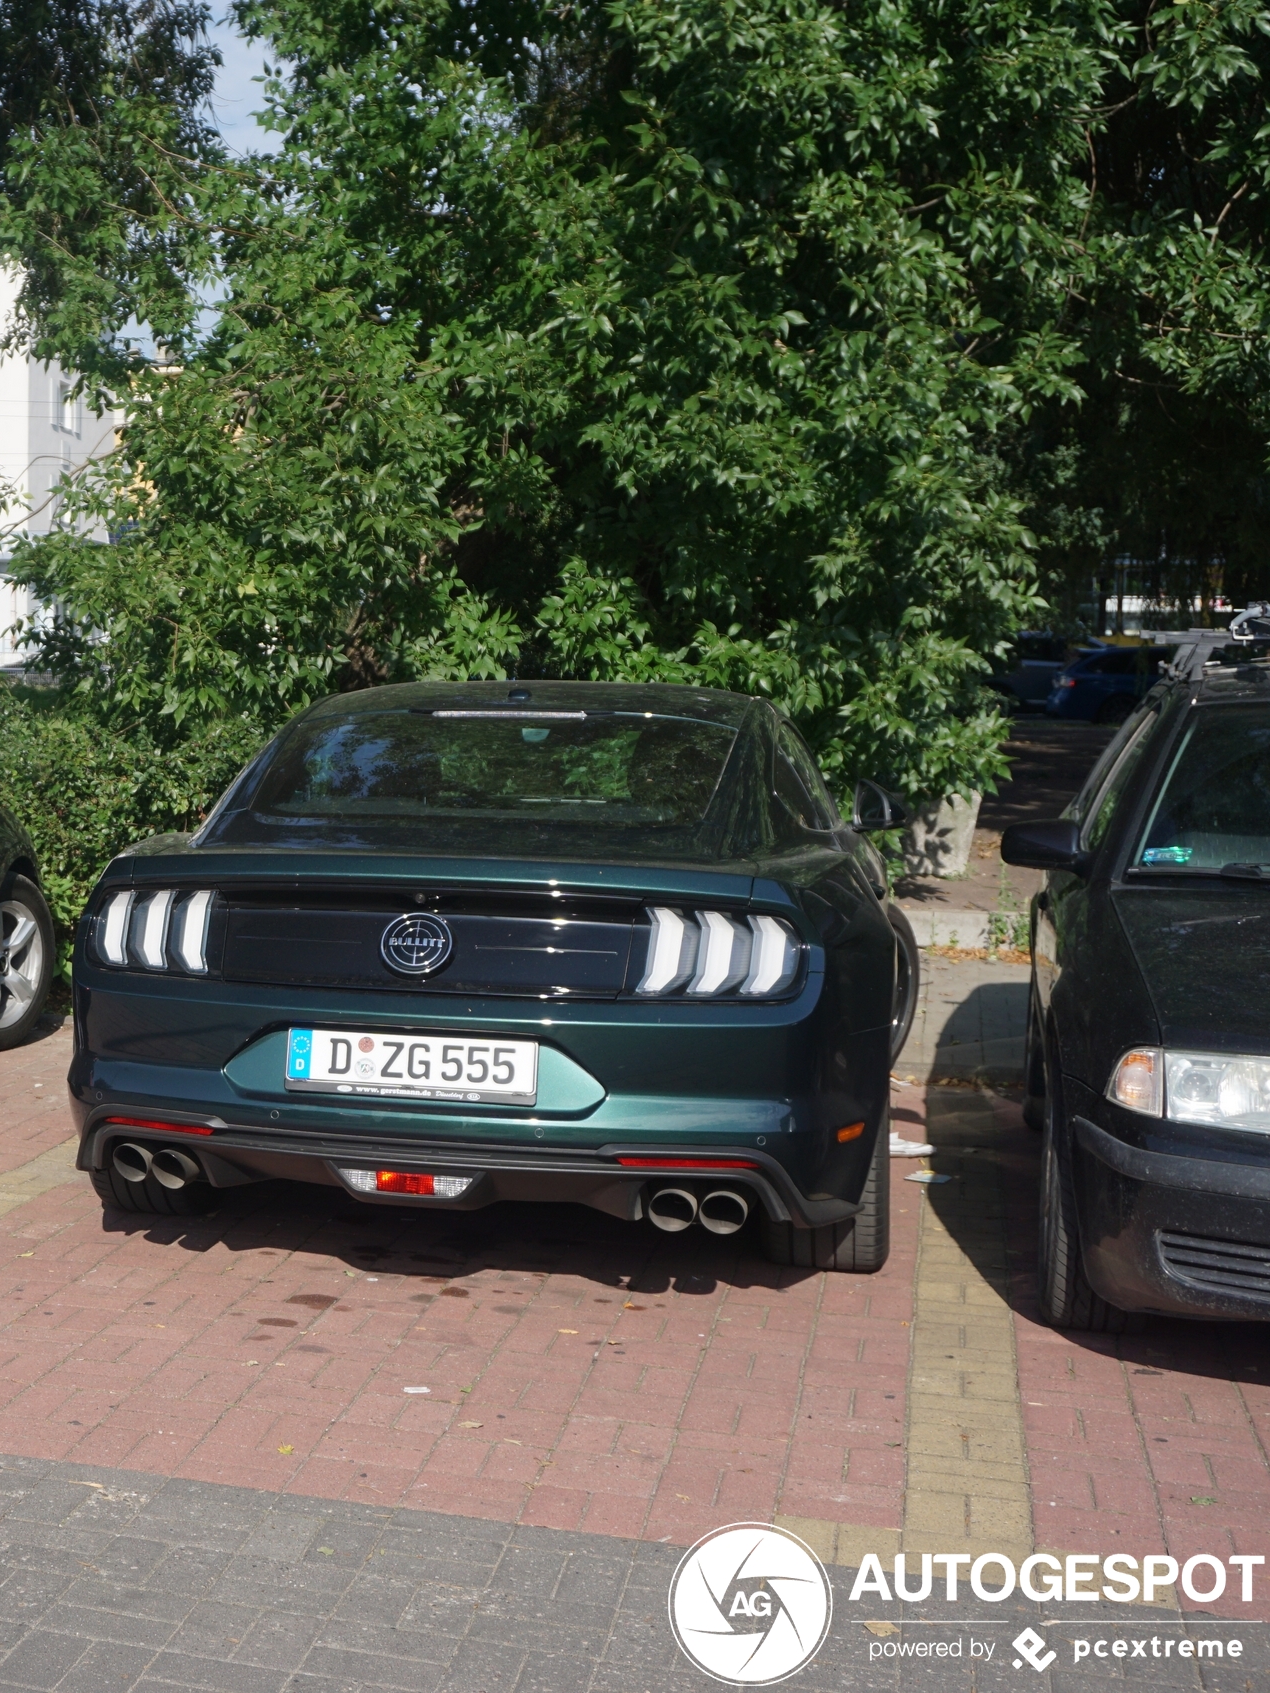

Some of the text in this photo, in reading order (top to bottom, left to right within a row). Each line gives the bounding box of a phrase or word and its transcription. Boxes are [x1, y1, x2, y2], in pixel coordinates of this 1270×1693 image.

[388, 937, 446, 948] BULLITT
[295, 1058, 305, 1071] D
[327, 1037, 517, 1085] D ZG 555
[435, 1090, 464, 1100] Düsseldorf
